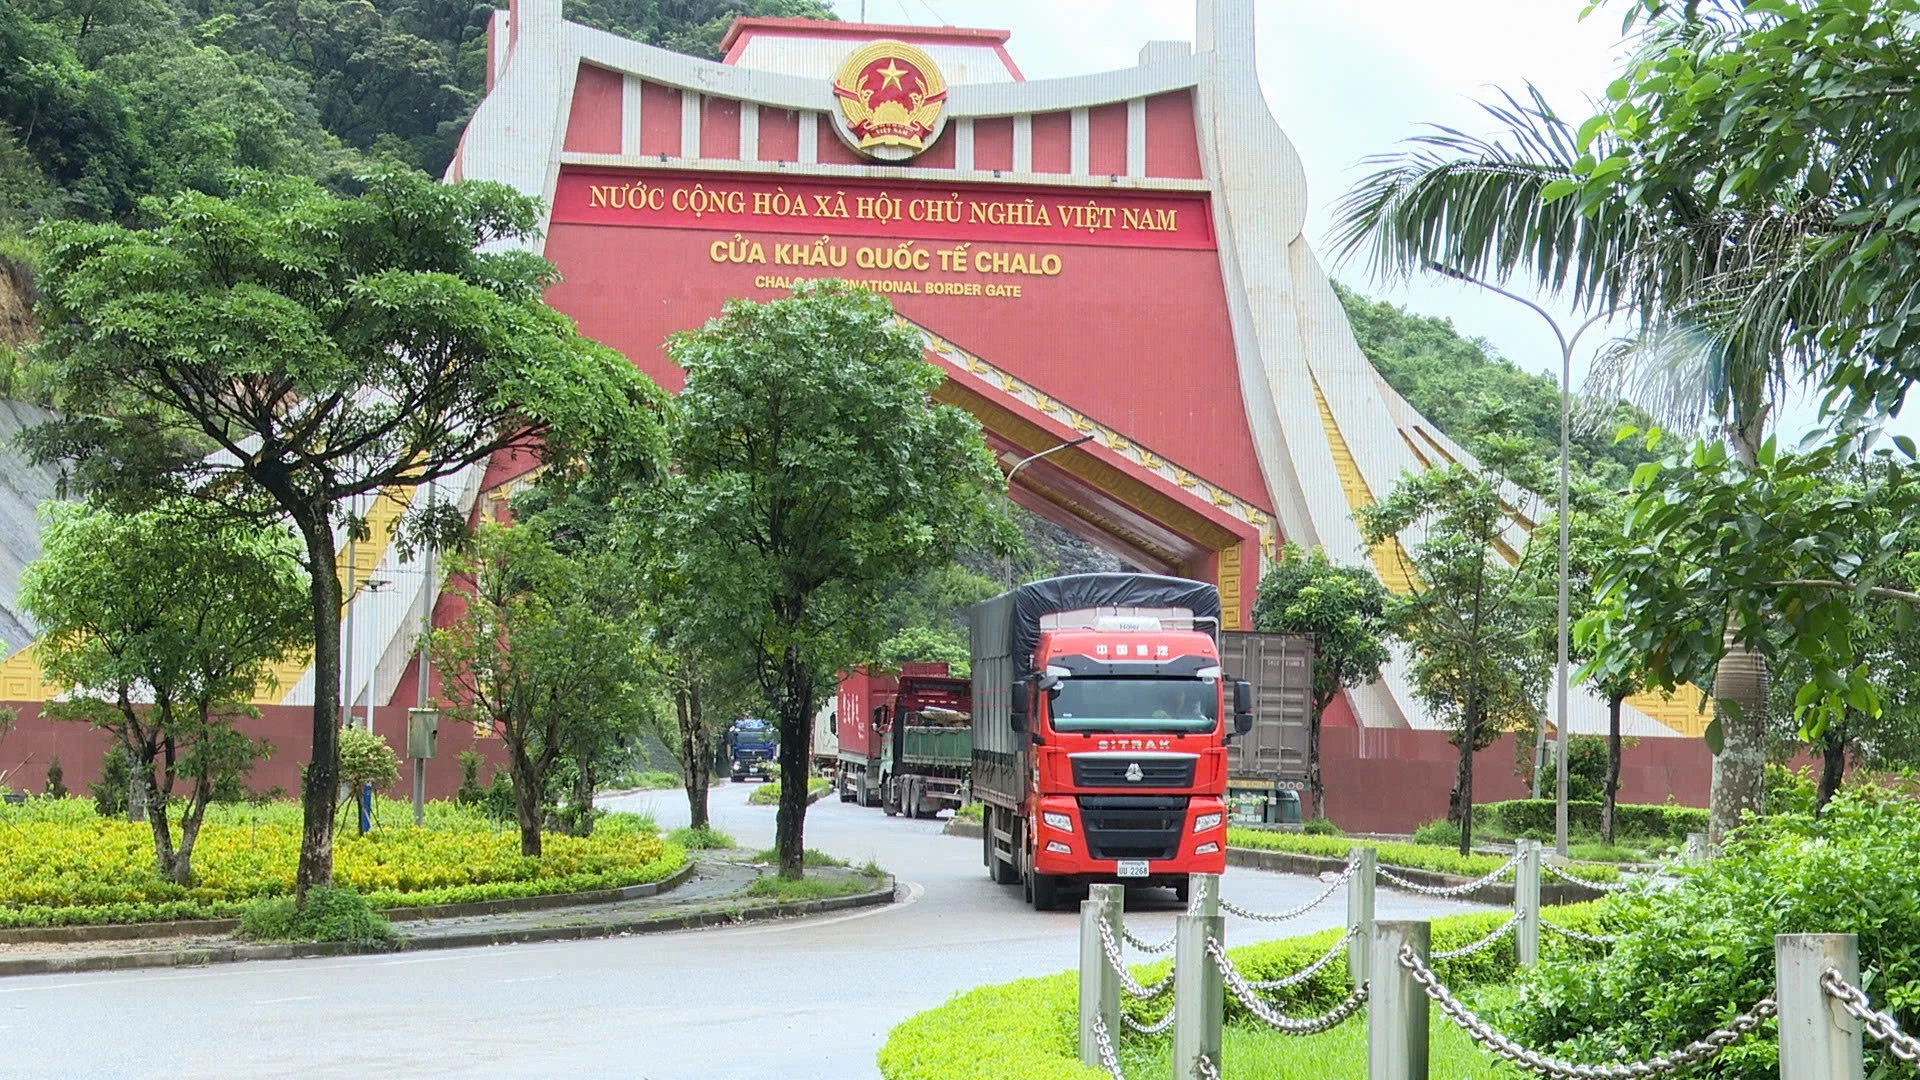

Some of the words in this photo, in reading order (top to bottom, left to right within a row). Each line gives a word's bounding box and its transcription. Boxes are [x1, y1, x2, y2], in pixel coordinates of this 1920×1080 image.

[589, 181, 665, 211] NƯỚC
[672, 184, 746, 217] CỘNG
[752, 187, 808, 217] HÒA
[813, 191, 850, 218] XÃ
[856, 192, 903, 225] HỘI
[909, 192, 963, 222] CHỦ
[969, 199, 1052, 227] NGHĨA
[1056, 201, 1116, 234] VIỆT
[1121, 208, 1178, 231] NAM
[710, 233, 767, 264] CỬA
[774, 235, 848, 267] KHẨU
[855, 241, 930, 271] QUỐC
[937, 242, 972, 272] TẾ
[974, 251, 1063, 276] CHALO
[925, 281, 981, 297] BORDER
[985, 284, 1022, 298] GATE
[1098, 740, 1171, 750] SITRAK
